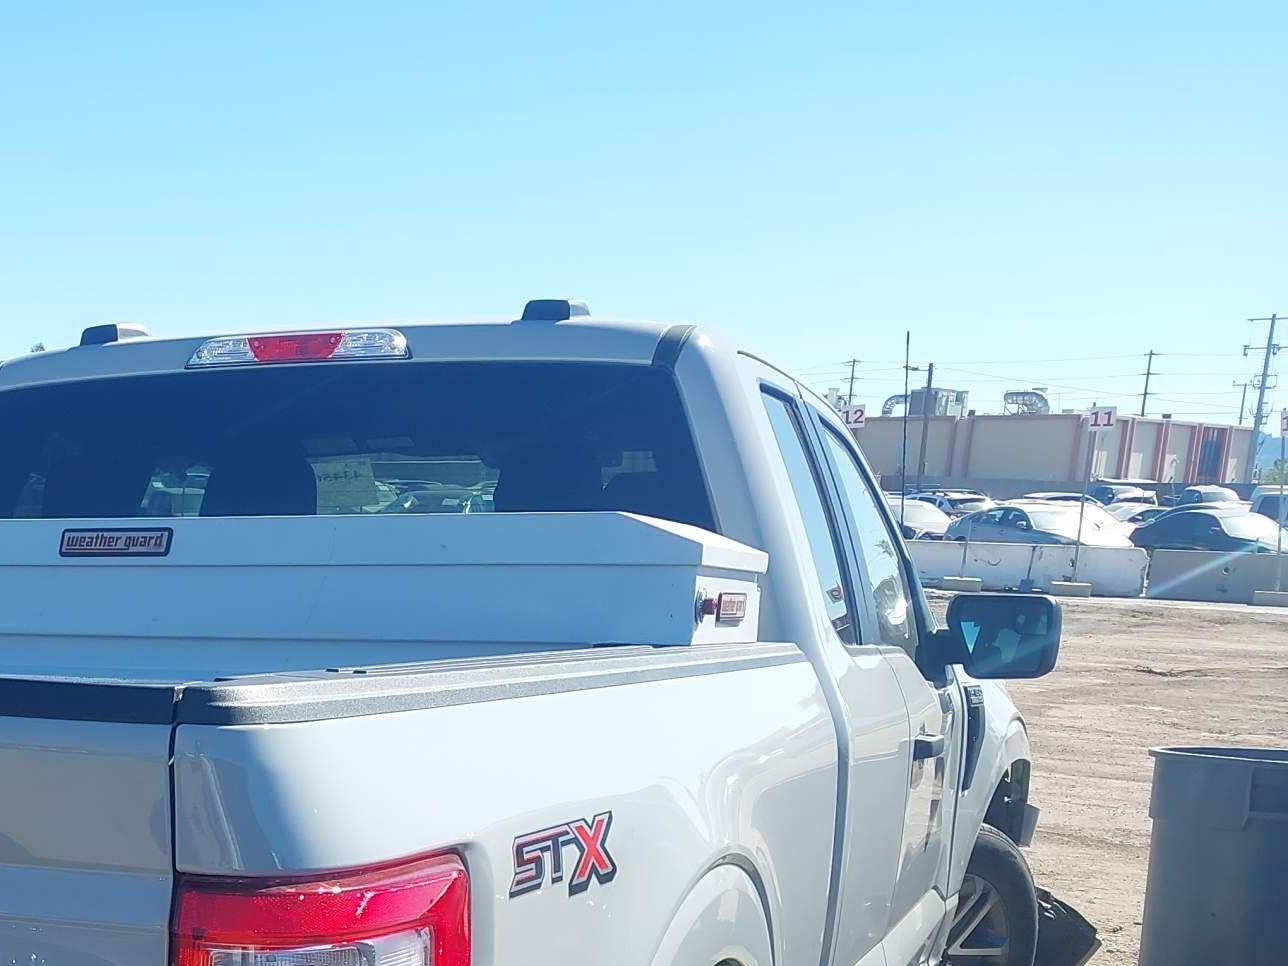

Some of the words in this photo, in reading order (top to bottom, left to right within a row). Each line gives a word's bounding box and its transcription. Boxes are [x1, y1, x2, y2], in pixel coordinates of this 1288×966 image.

[842, 408, 864, 425] 12
[1090, 411, 1114, 427] 11
[66, 533, 121, 547] weather
[123, 533, 164, 549] guard
[509, 810, 617, 898] STX
